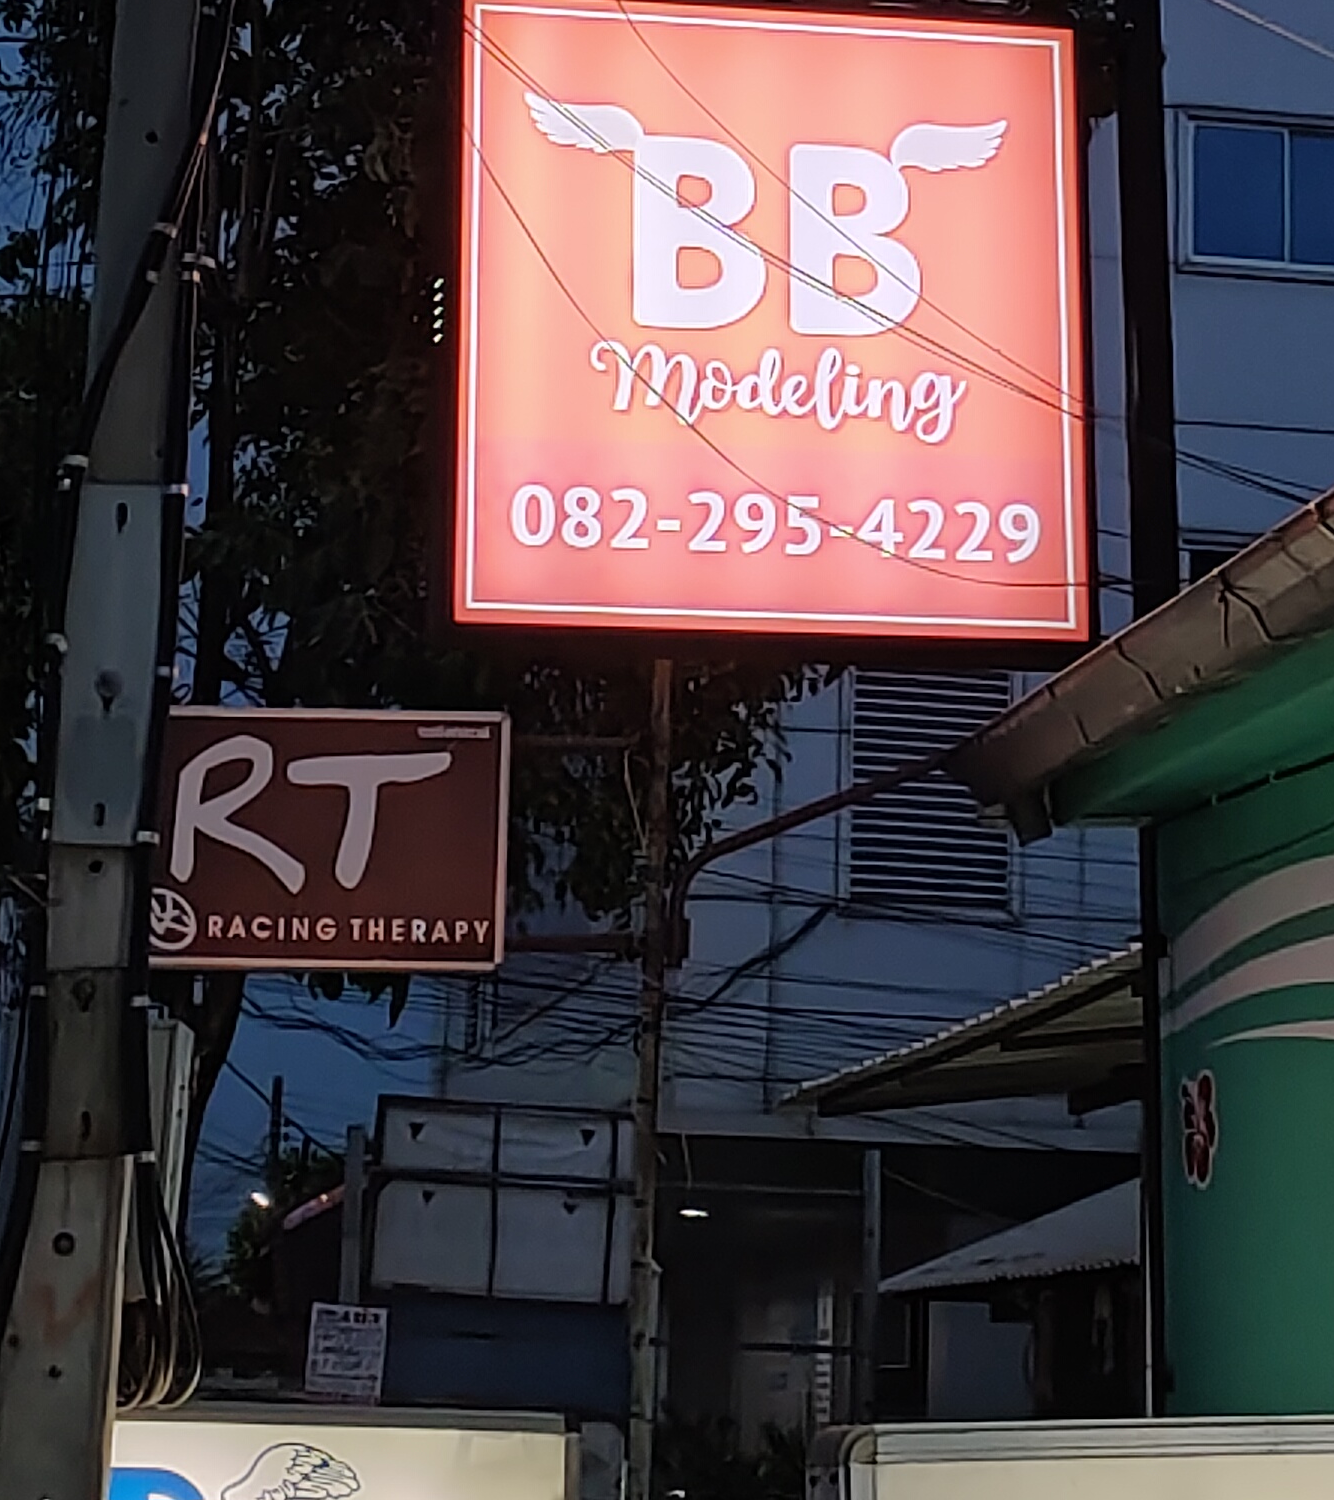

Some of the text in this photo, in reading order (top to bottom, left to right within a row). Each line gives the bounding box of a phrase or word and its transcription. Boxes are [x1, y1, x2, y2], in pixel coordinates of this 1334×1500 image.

[633, 134, 921, 336] BB
[590, 339, 967, 444] Modeling
[511, 485, 1041, 563] 082-295-4229
[169, 733, 453, 895] RT
[206, 914, 491, 945] RACING THERAPY
